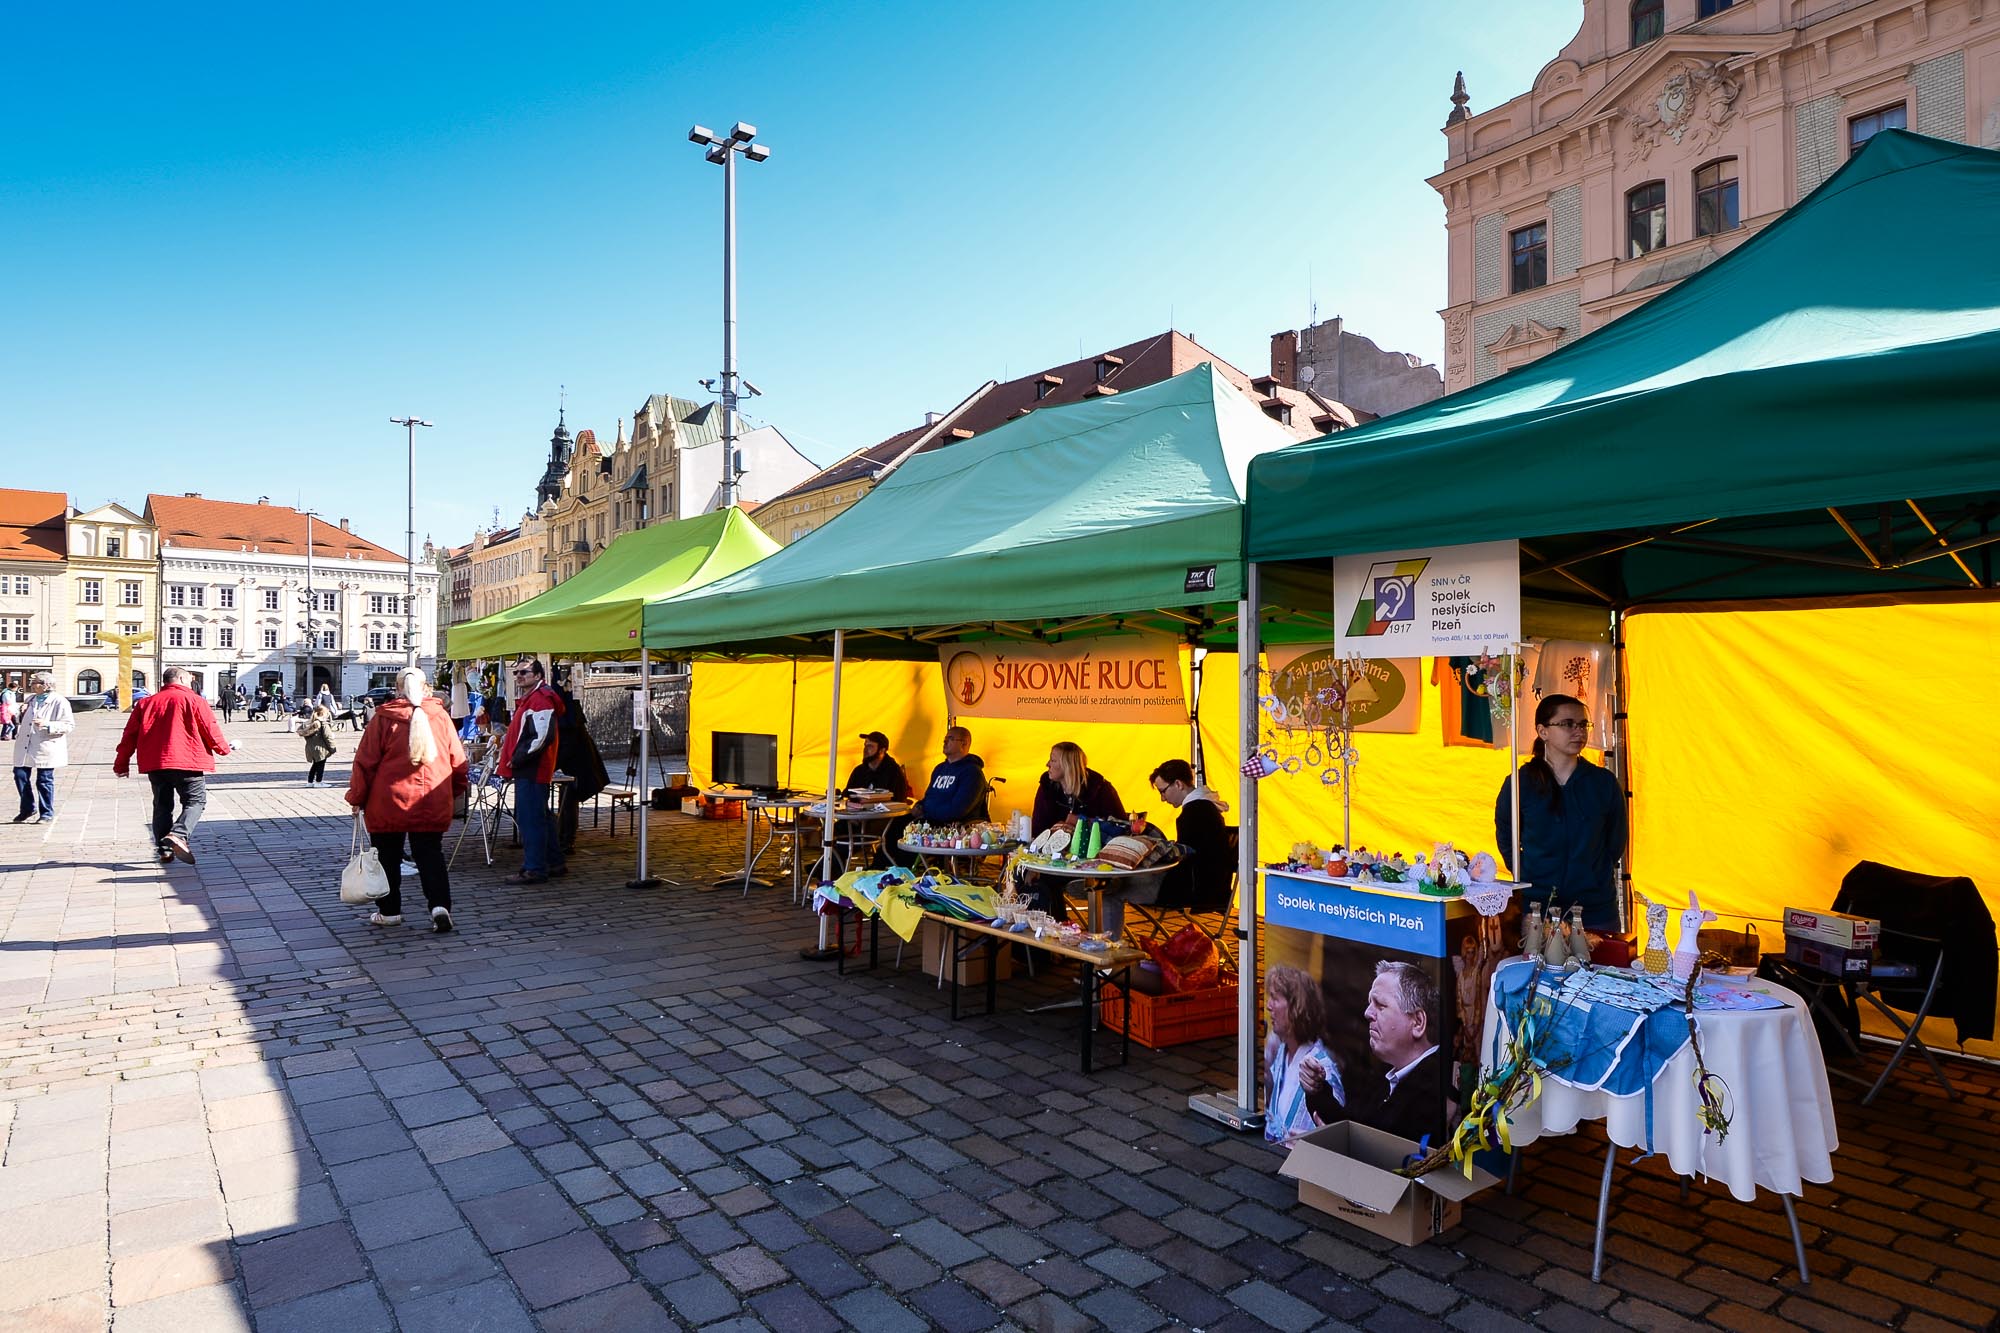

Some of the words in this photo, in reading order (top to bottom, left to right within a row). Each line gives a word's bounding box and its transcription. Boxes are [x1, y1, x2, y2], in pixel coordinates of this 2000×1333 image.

[1431, 578, 1449, 587] SNN
[1458, 574, 1471, 585] ČR
[1431, 589, 1471, 604] Spolek
[1431, 602, 1496, 617] neslyšících
[1388, 623, 1412, 634] 1917
[1432, 618, 1462, 631] Plzeň
[992, 652, 1091, 690] ŠIKOVNÉ
[1098, 658, 1168, 690] RUCE
[1016, 695, 1052, 706] prezentace
[1053, 695, 1079, 707] výrobků
[1090, 697, 1098, 705] se
[1099, 695, 1141, 705] zdravotním
[1143, 695, 1185, 708] postižením
[1277, 893, 1316, 912] Spolek
[1318, 902, 1386, 924] neslyšících
[1389, 912, 1424, 931] Plzeň
